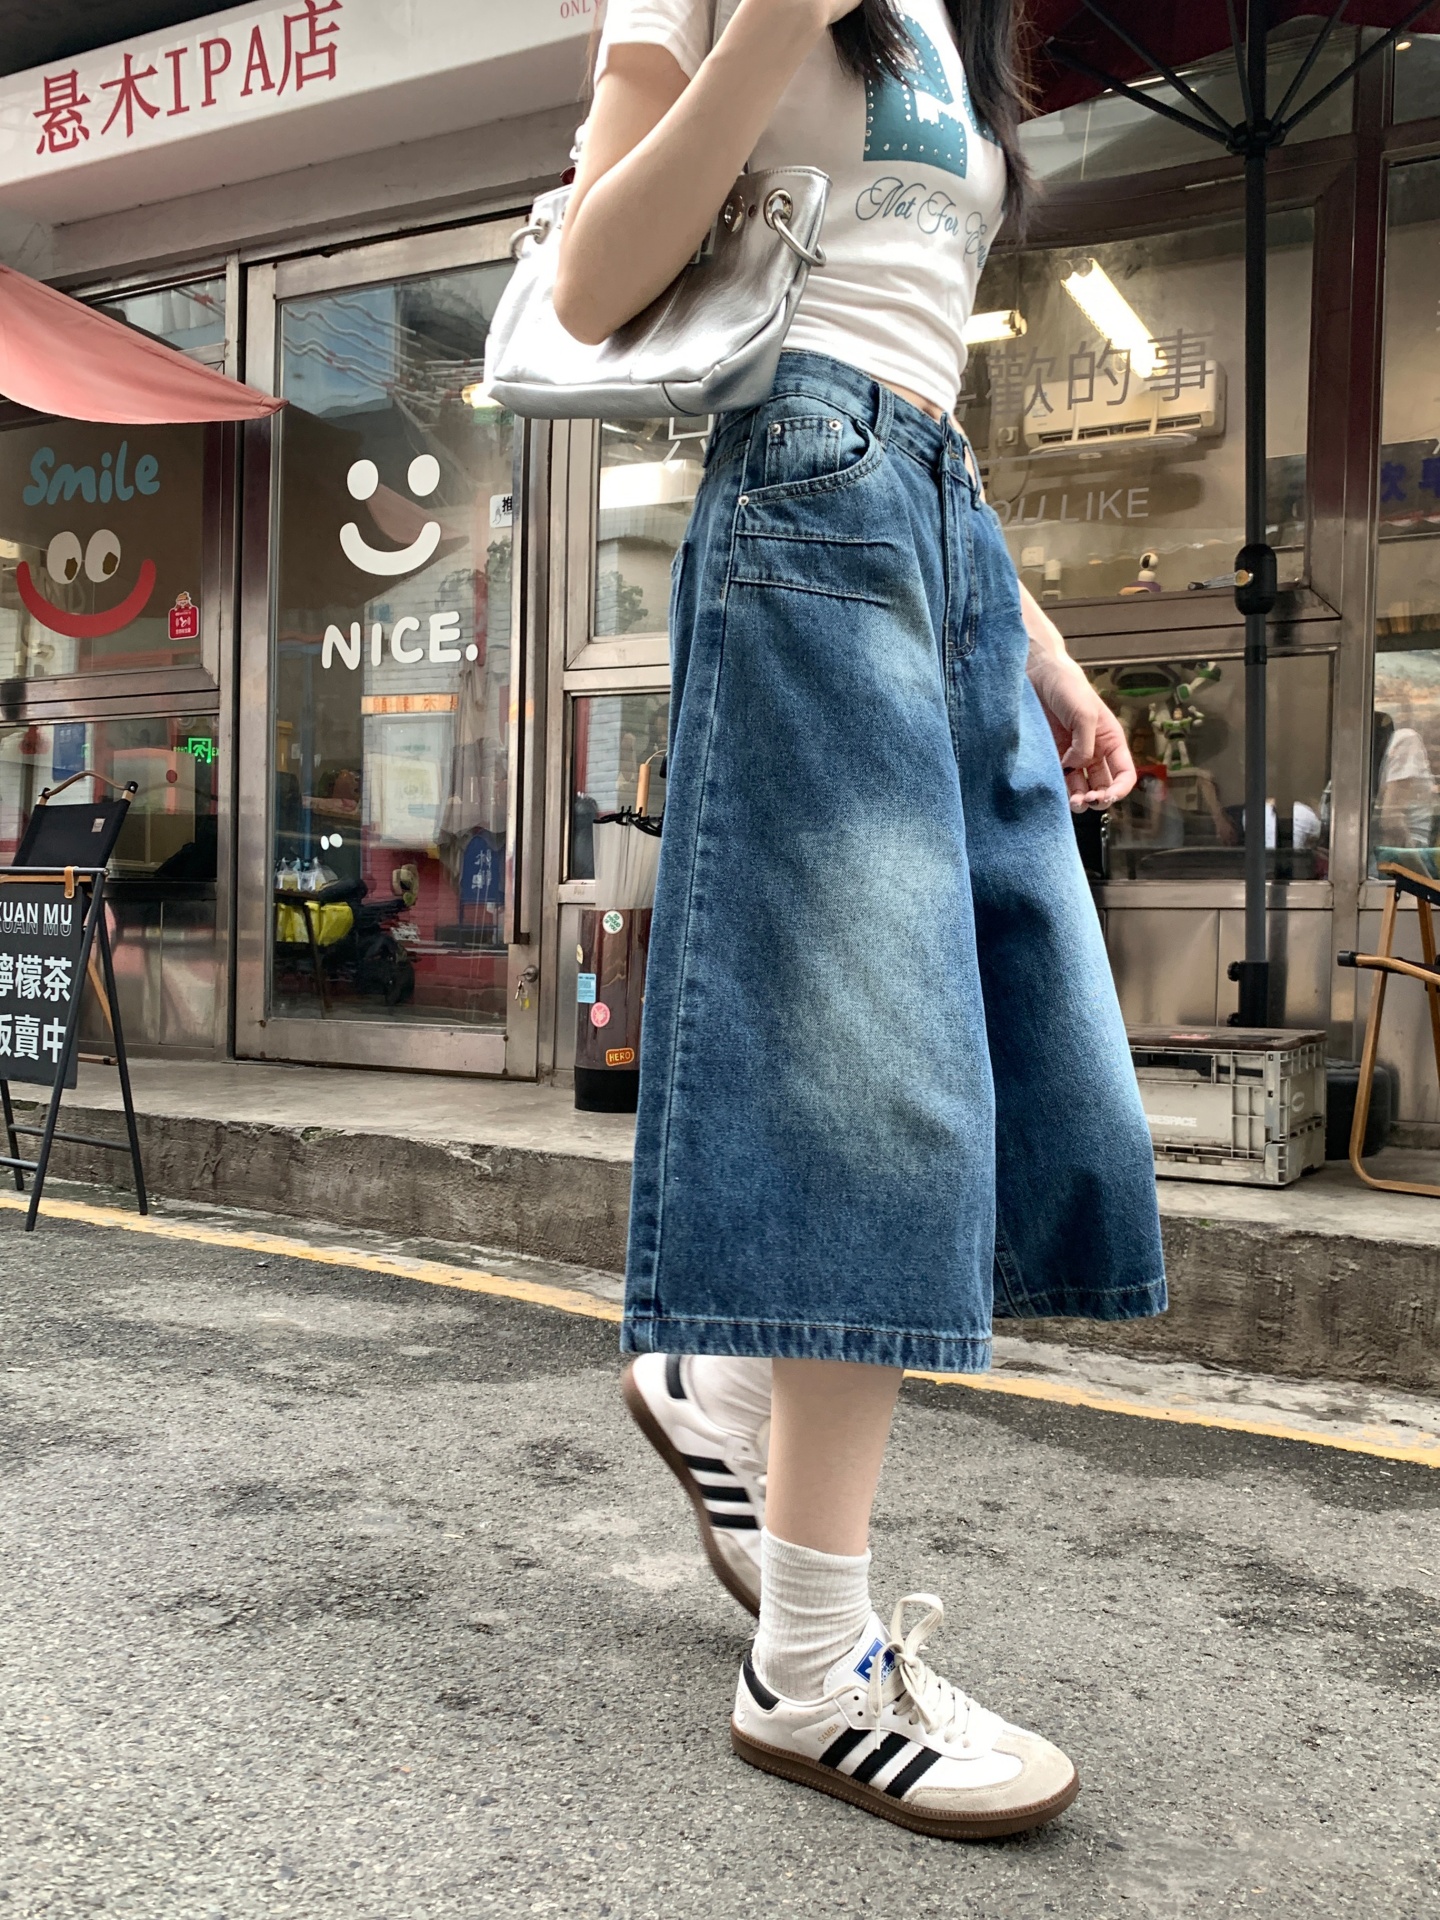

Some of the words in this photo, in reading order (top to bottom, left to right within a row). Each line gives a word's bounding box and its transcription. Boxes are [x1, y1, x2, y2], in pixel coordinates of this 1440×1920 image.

[33, 0, 343, 155] 悬木IPA店
[855, 176, 927, 222] Not
[916, 190, 960, 236] For
[952, 328, 1215, 421] 歡的事
[23, 440, 161, 506] Smile
[1060, 487, 1150, 523] LIKE
[321, 610, 479, 671] NICE.
[0, 901, 39, 923] UAN
[43, 903, 73, 925] MU
[609, 1051, 631, 1062] HERO
[817, 1723, 840, 1745] SAMBA
